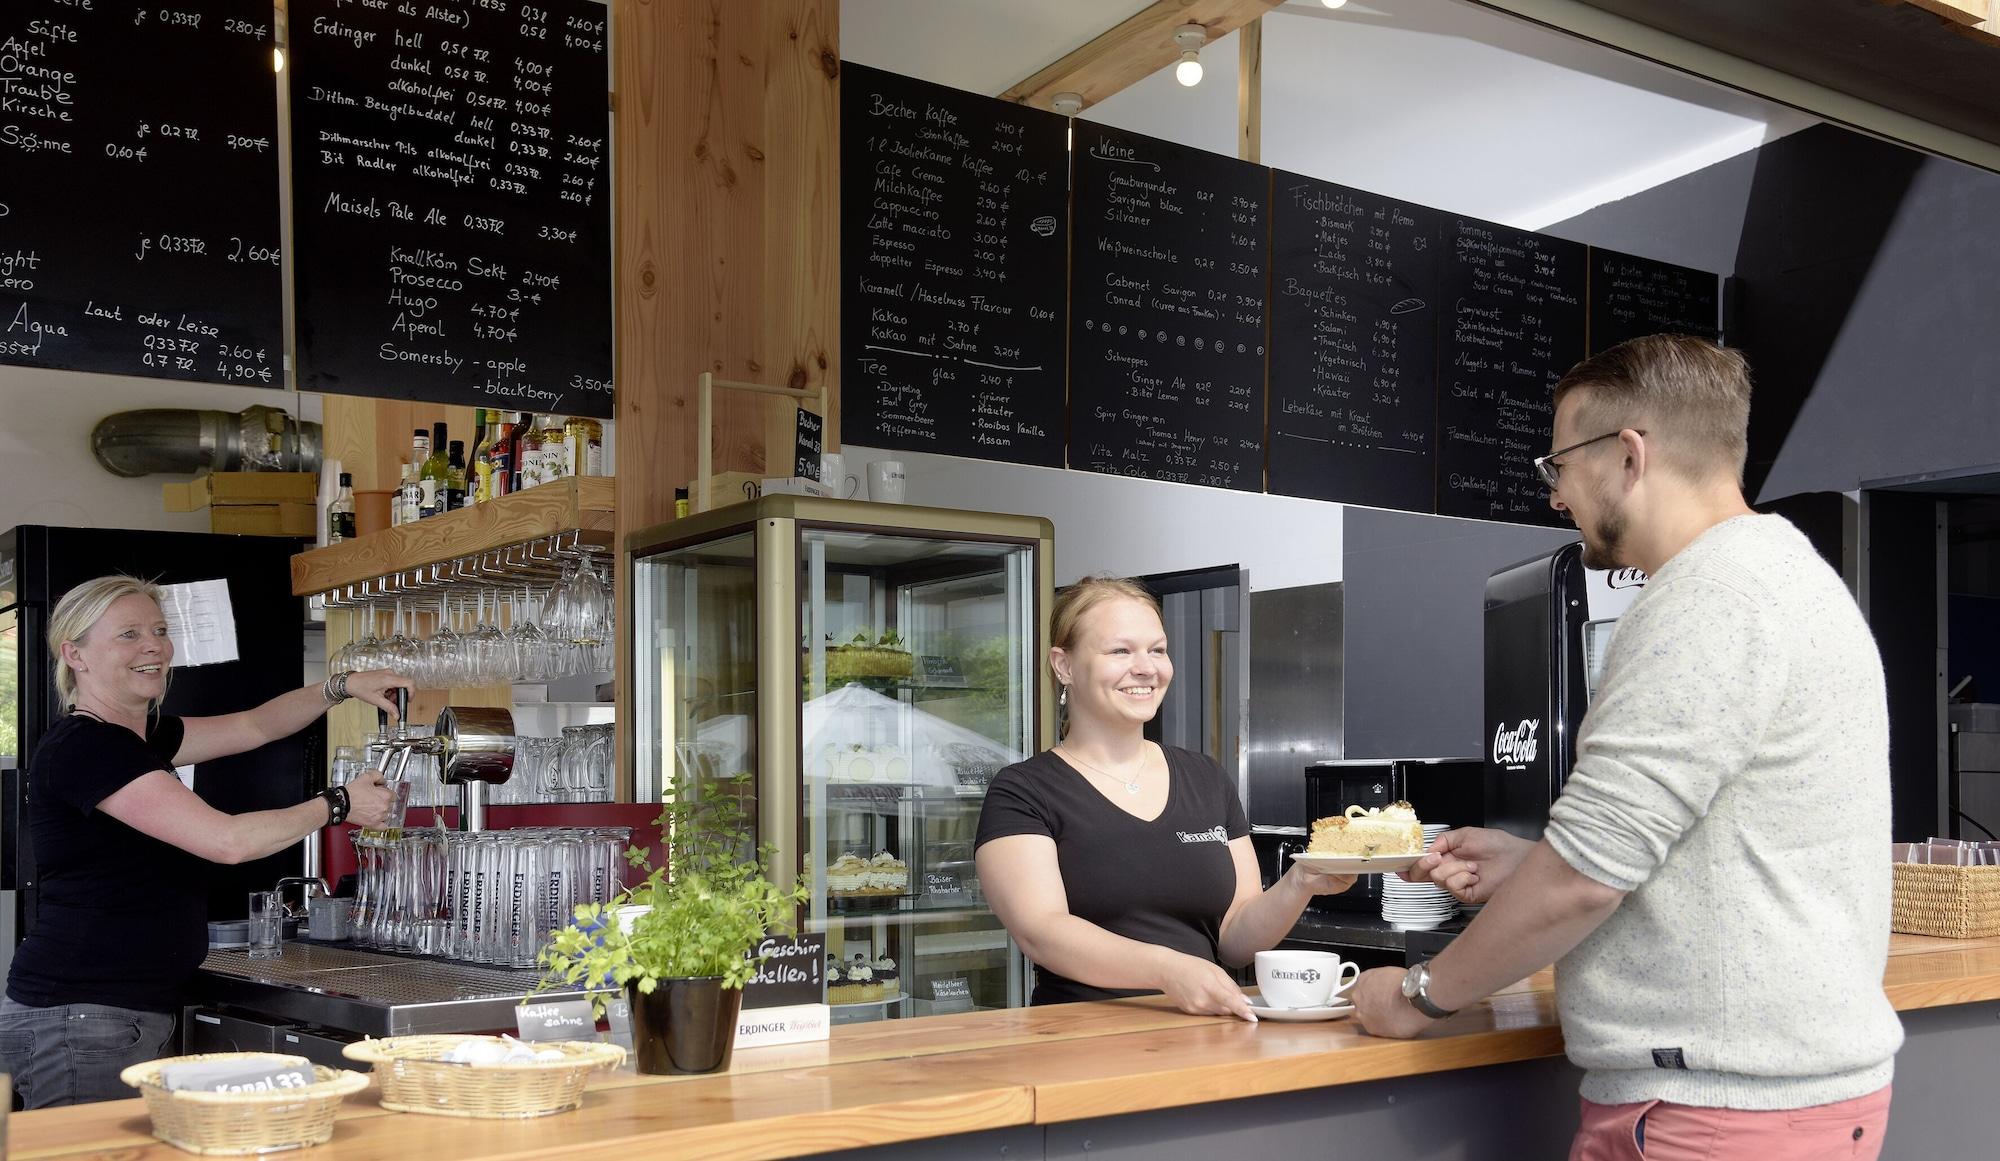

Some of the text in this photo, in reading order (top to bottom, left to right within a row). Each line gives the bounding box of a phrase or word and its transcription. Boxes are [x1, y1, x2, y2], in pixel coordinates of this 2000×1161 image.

[398, 1, 416, 16] als
[425, 6, 469, 29] Alster)
[314, 17, 376, 48] Erdinger
[395, 29, 422, 48] hell
[1, 36, 45, 60] Apfel
[0, 55, 76, 94] Orange
[391, 54, 431, 75] dunkel
[0, 77, 75, 105] Traube
[3, 97, 73, 121] Kirsche
[365, 94, 455, 125] Beugelbuddel
[471, 116, 493, 131] hell
[869, 94, 957, 127] Becher Kaffee
[320, 131, 390, 150] Dithmarscher
[395, 141, 417, 155] Pils
[455, 131, 494, 149] dunkel
[1101, 136, 1134, 160] Weine
[320, 151, 344, 164] Bit
[357, 155, 396, 171] Radler
[962, 154, 993, 177] Kaffee
[912, 167, 945, 183] Crema
[1108, 172, 1176, 200] Grauburgunder
[325, 192, 380, 218] Maisels
[388, 202, 413, 220] Pale
[424, 208, 446, 225] Ale
[874, 196, 941, 220] Cappuccino
[1160, 198, 1183, 214] blanc
[867, 214, 892, 230] Latte
[1105, 208, 1150, 225] Silvaner
[1392, 208, 1414, 226] Remo
[873, 235, 915, 251] Espresso
[1320, 230, 1348, 249] Matjes
[1319, 243, 1345, 261] Lachs
[468, 257, 506, 280] Sekt
[870, 251, 963, 276] doppelter Espresso
[390, 267, 462, 291] Prosecco
[1106, 273, 1150, 291] Cabernet
[860, 276, 1012, 314] Karamell Flavour
[1106, 292, 1141, 308] Conrad
[1282, 277, 1346, 307] Baguettes
[1493, 284, 1513, 296] Cream
[388, 289, 437, 317] Hugo
[85, 301, 122, 320] Laut
[138, 313, 170, 327] oder
[177, 314, 218, 338] Leise
[392, 312, 445, 341] Aperol
[1318, 321, 1346, 335] Salami
[919, 334, 936, 351] mit
[943, 336, 977, 352] Sahne
[380, 343, 526, 378] Somersby apple
[858, 359, 887, 375] Tee
[1105, 349, 1148, 368] Schweppes
[1320, 349, 1366, 371] Vegetarisch
[1132, 370, 1185, 391] Ginger Ale
[877, 381, 922, 401] Darjeeling
[1158, 390, 1178, 401] Lemon
[883, 397, 927, 413] Earl Grey
[1095, 407, 1116, 422] Spicy
[1123, 409, 1149, 427] Ginger
[1349, 410, 1370, 424] Kraut
[881, 418, 1045, 439] Pfefferminze Rooibos Vanilla
[978, 433, 1010, 445] Assam
[1146, 427, 1177, 439] Thomas
[1182, 429, 1205, 451] Henry
[1092, 444, 1112, 457] Vita
[1123, 448, 1149, 461] Malz
[1124, 464, 1149, 478] Cola
[1493, 719, 1539, 764] Coca-Cola
[928, 875, 953, 884] Baiser
[511, 874, 524, 938] ERDINGER
[1272, 970, 1300, 979] Kanal
[519, 1006, 560, 1018] Kaffee
[544, 1015, 583, 1027] sahne
[739, 1022, 785, 1035] ERDINGER
[276, 1072, 306, 1089] 33
